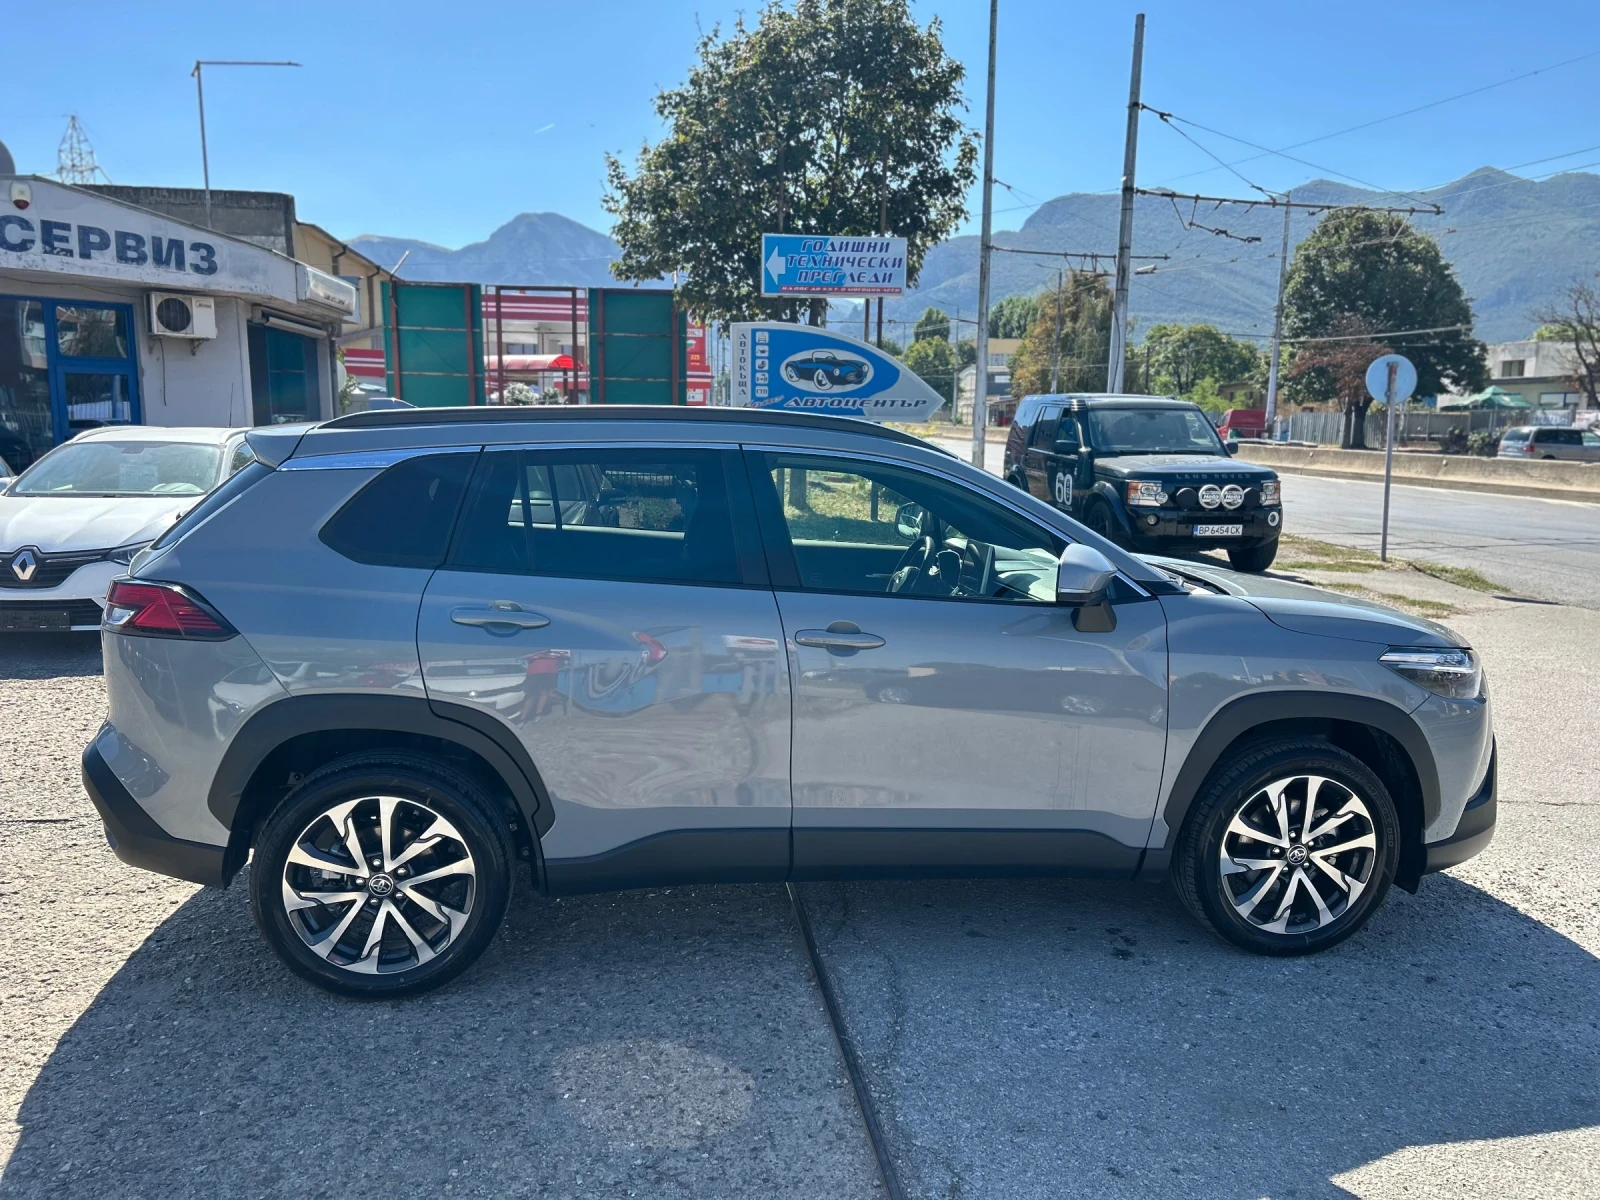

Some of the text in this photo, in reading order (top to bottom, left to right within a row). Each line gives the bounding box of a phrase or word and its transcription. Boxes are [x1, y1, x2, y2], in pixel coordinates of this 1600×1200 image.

[0, 214, 218, 276] СЕРВИЗ
[801, 240, 890, 253] ГОДИШНИ
[787, 254, 903, 268] ТЕХНИЧЕСКИ
[797, 270, 893, 283] ПРЕГЛЕДИ
[738, 333, 747, 395] АВТОКЪЩА
[784, 396, 927, 408] АВТОЦЕНТЪР
[1056, 472, 1072, 505] 60
[1198, 525, 1241, 535] BP 6454 CK
